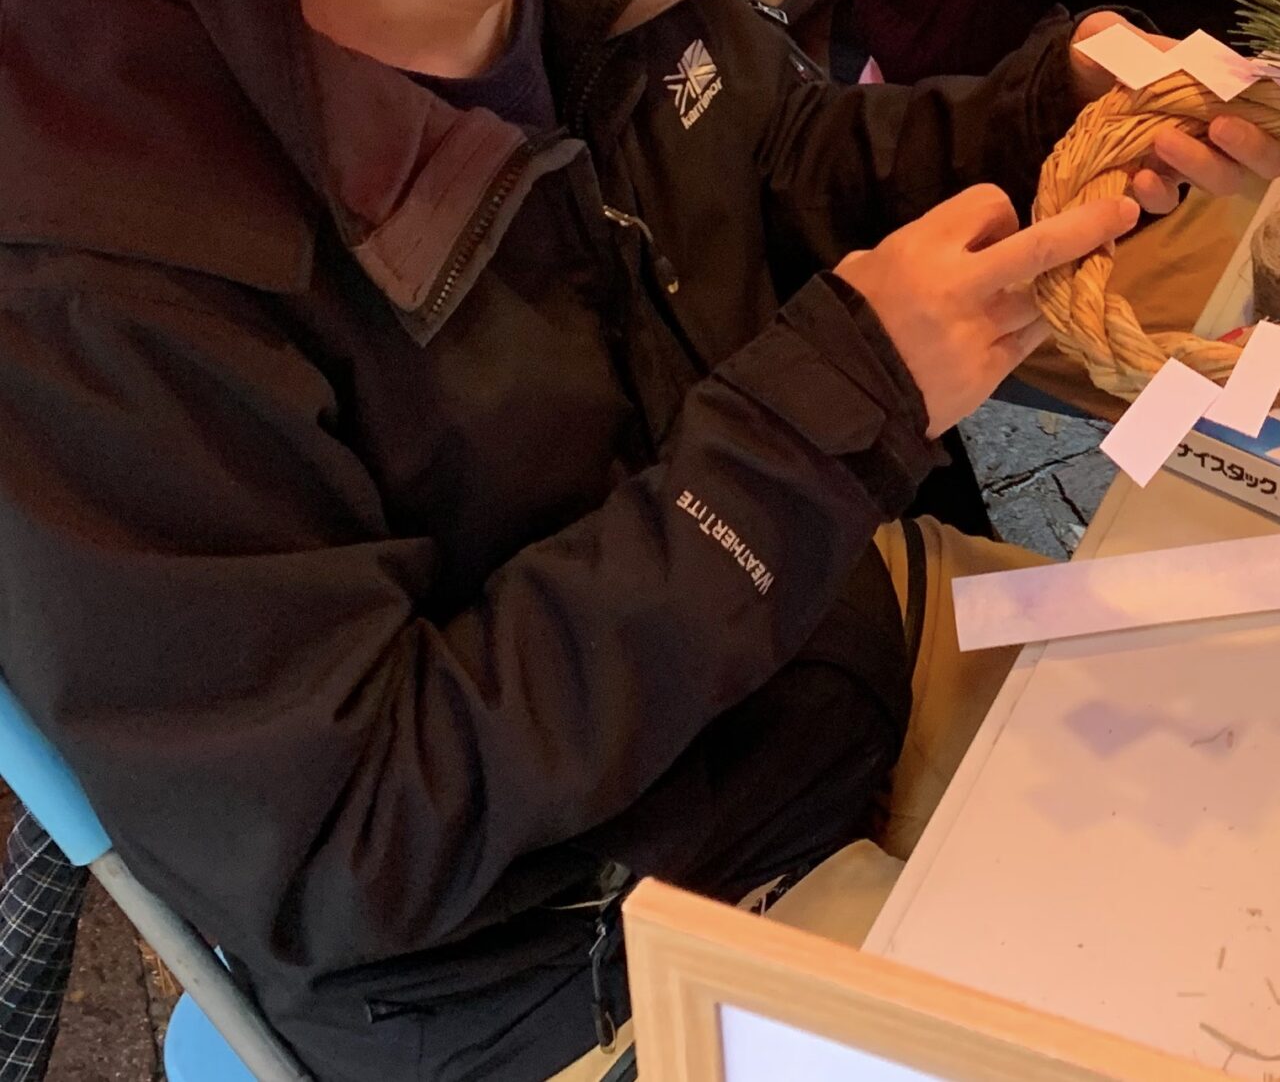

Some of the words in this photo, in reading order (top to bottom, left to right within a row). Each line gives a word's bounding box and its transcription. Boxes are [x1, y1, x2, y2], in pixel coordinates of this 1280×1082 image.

[680, 76, 723, 130] karrimor
[1177, 443, 1278, 495] ナイスタック
[675, 489, 775, 596] WEATHERTITE
